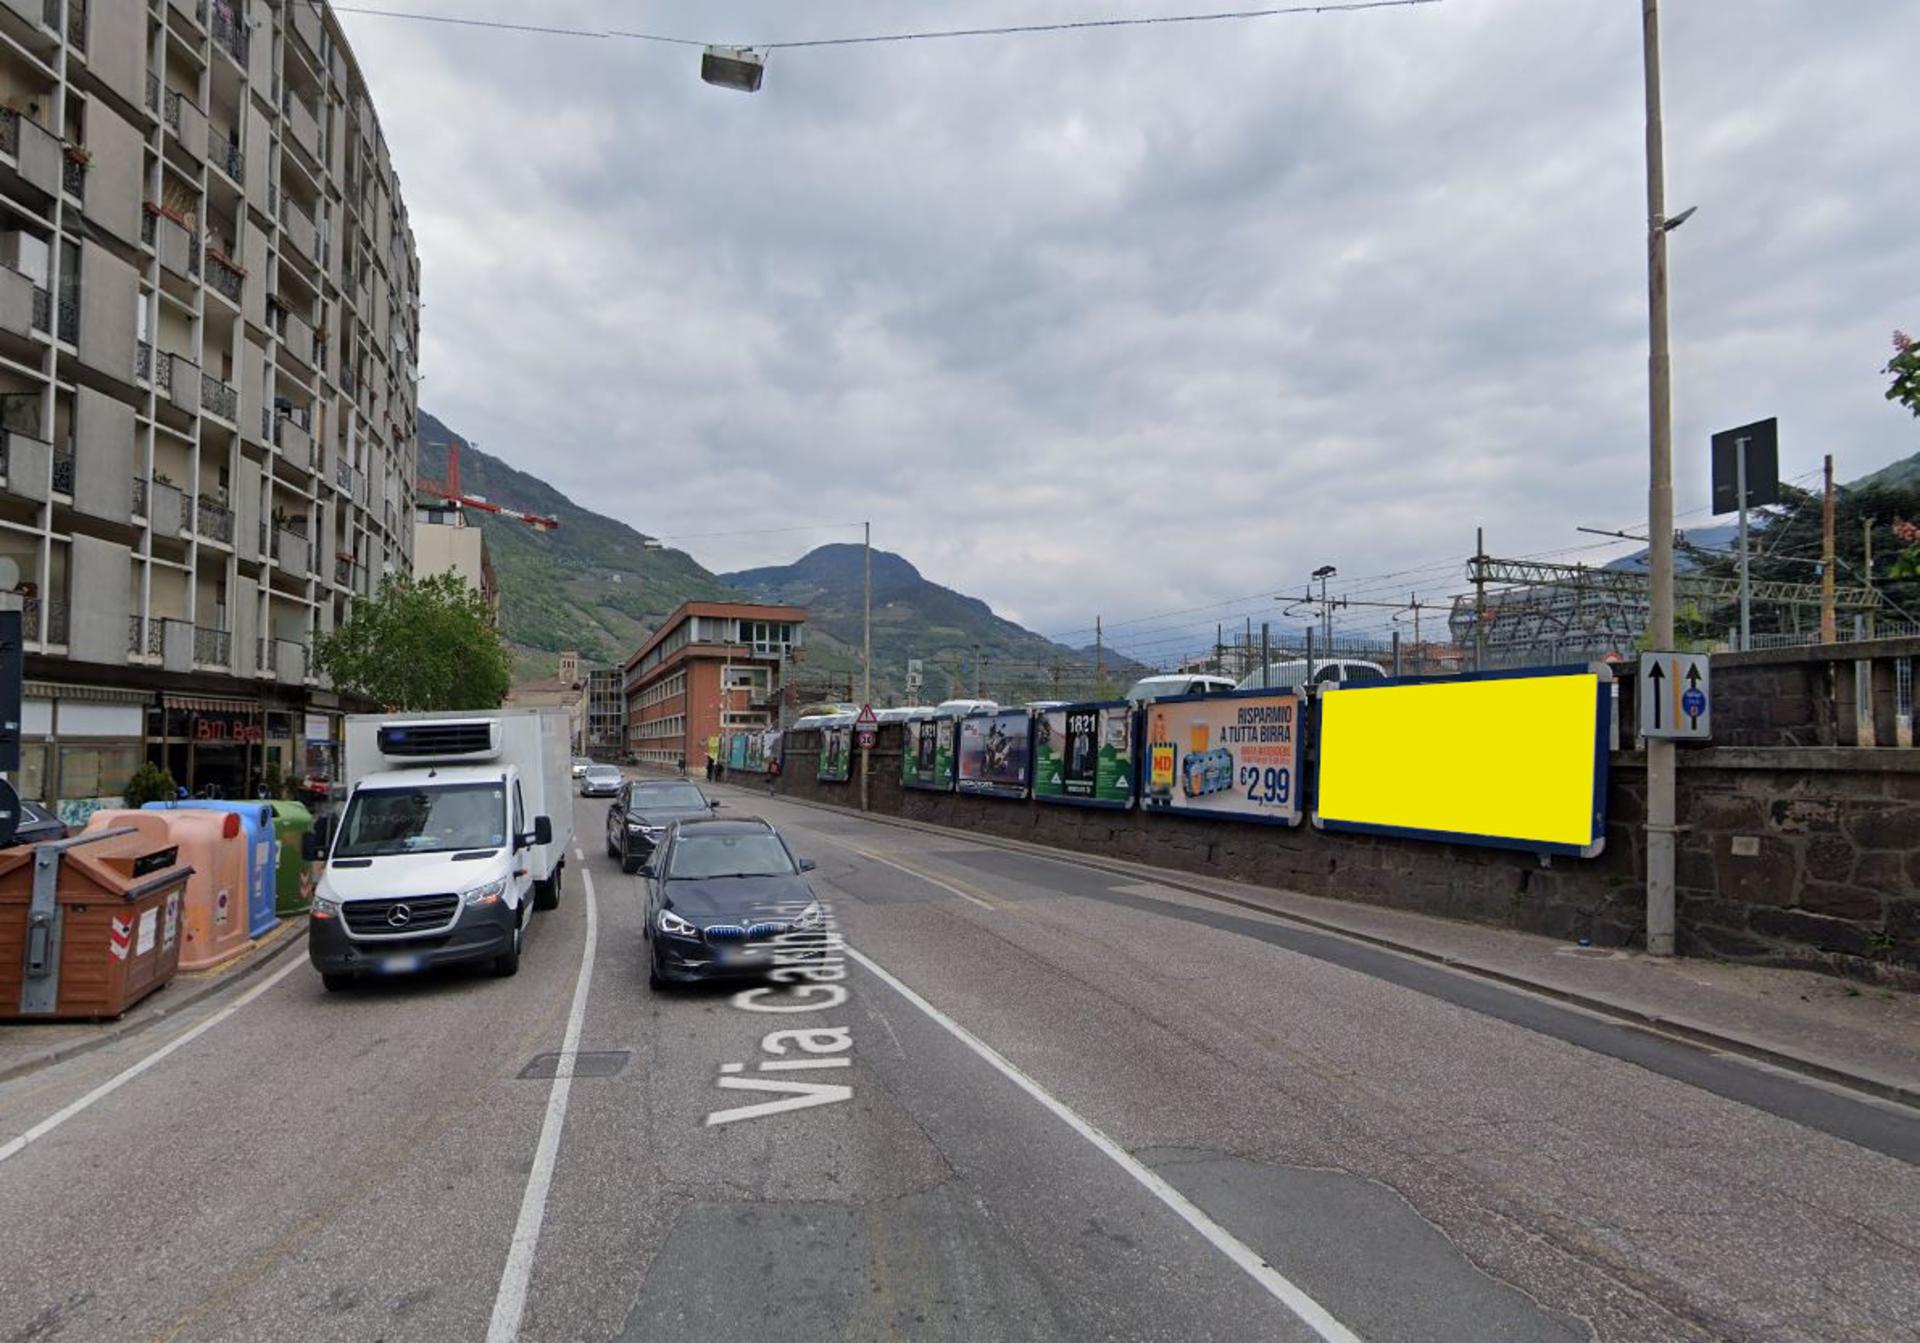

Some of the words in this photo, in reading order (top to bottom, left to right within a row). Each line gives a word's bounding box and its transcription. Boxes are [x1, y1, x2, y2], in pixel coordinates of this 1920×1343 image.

[1238, 706, 1292, 724] RISPARMIO
[1220, 726, 1227, 743] A
[1229, 725, 1258, 743] TUTTA
[1260, 725, 1291, 743] BIRRA
[1154, 755, 1171, 770] MD
